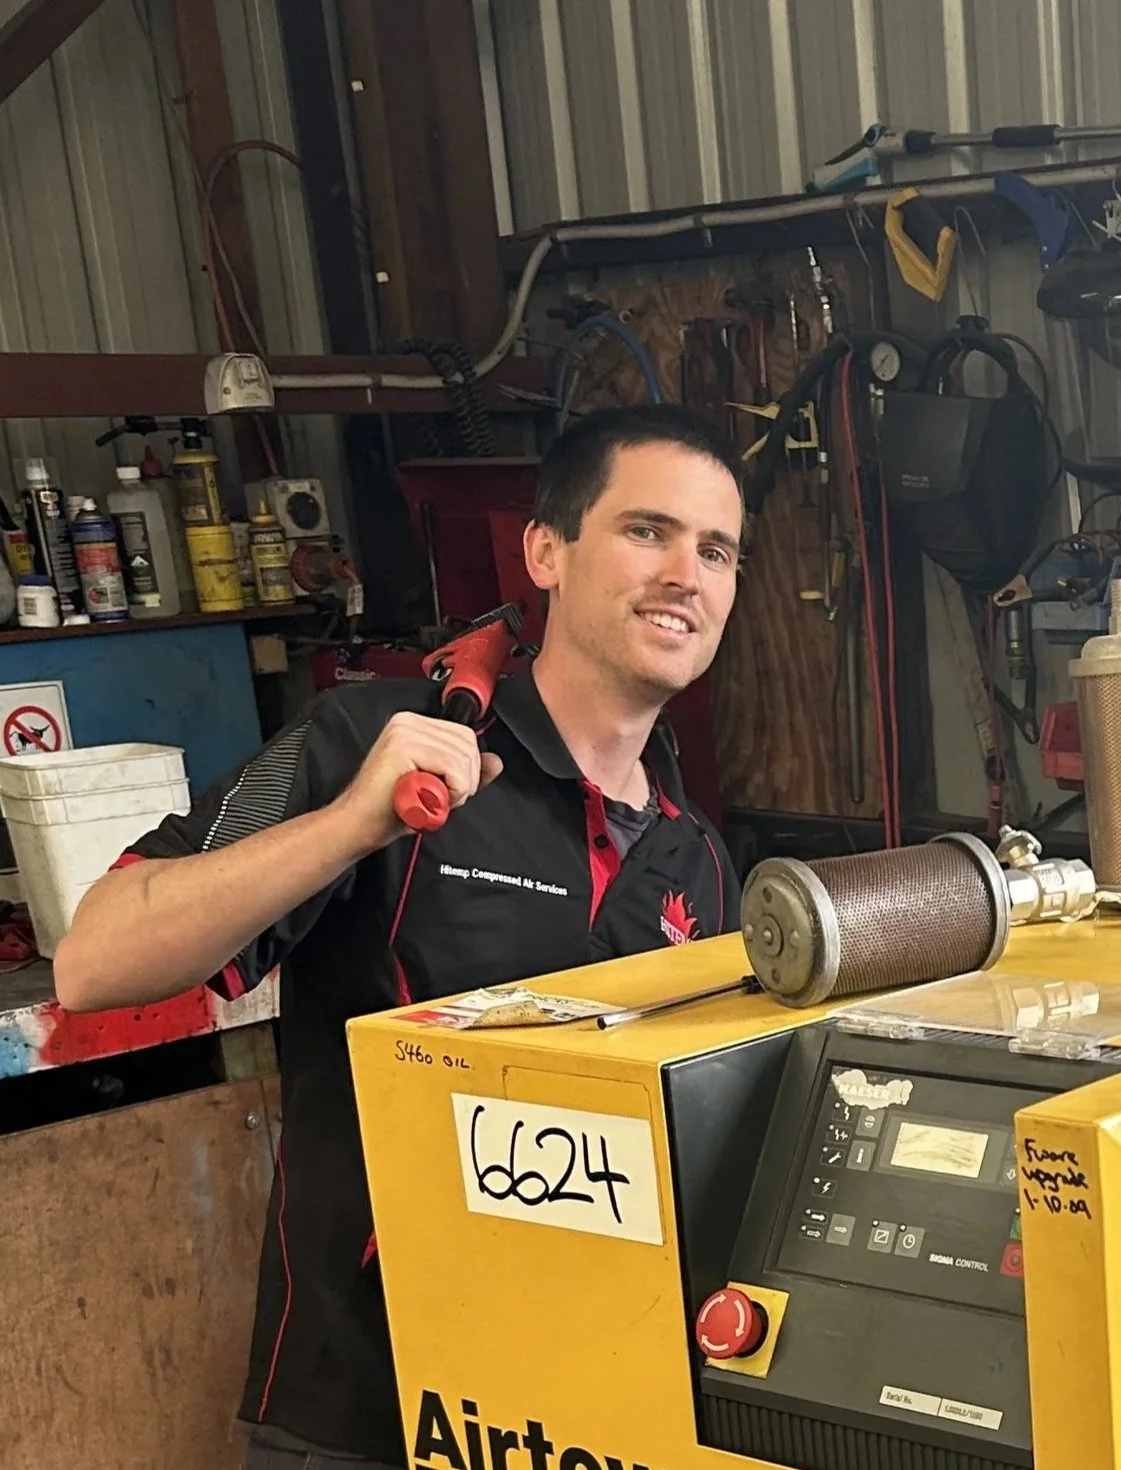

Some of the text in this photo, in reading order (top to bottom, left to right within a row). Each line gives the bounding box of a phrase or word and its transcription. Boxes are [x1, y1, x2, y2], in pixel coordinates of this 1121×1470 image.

[440, 864, 470, 879] Hitemp
[471, 868, 522, 887] Compressed
[535, 881, 568, 896] Services
[395, 1040, 433, 1065] S460
[471, 1105, 631, 1225] 6624
[929, 1253, 989, 1272] SIGMA CONTROL
